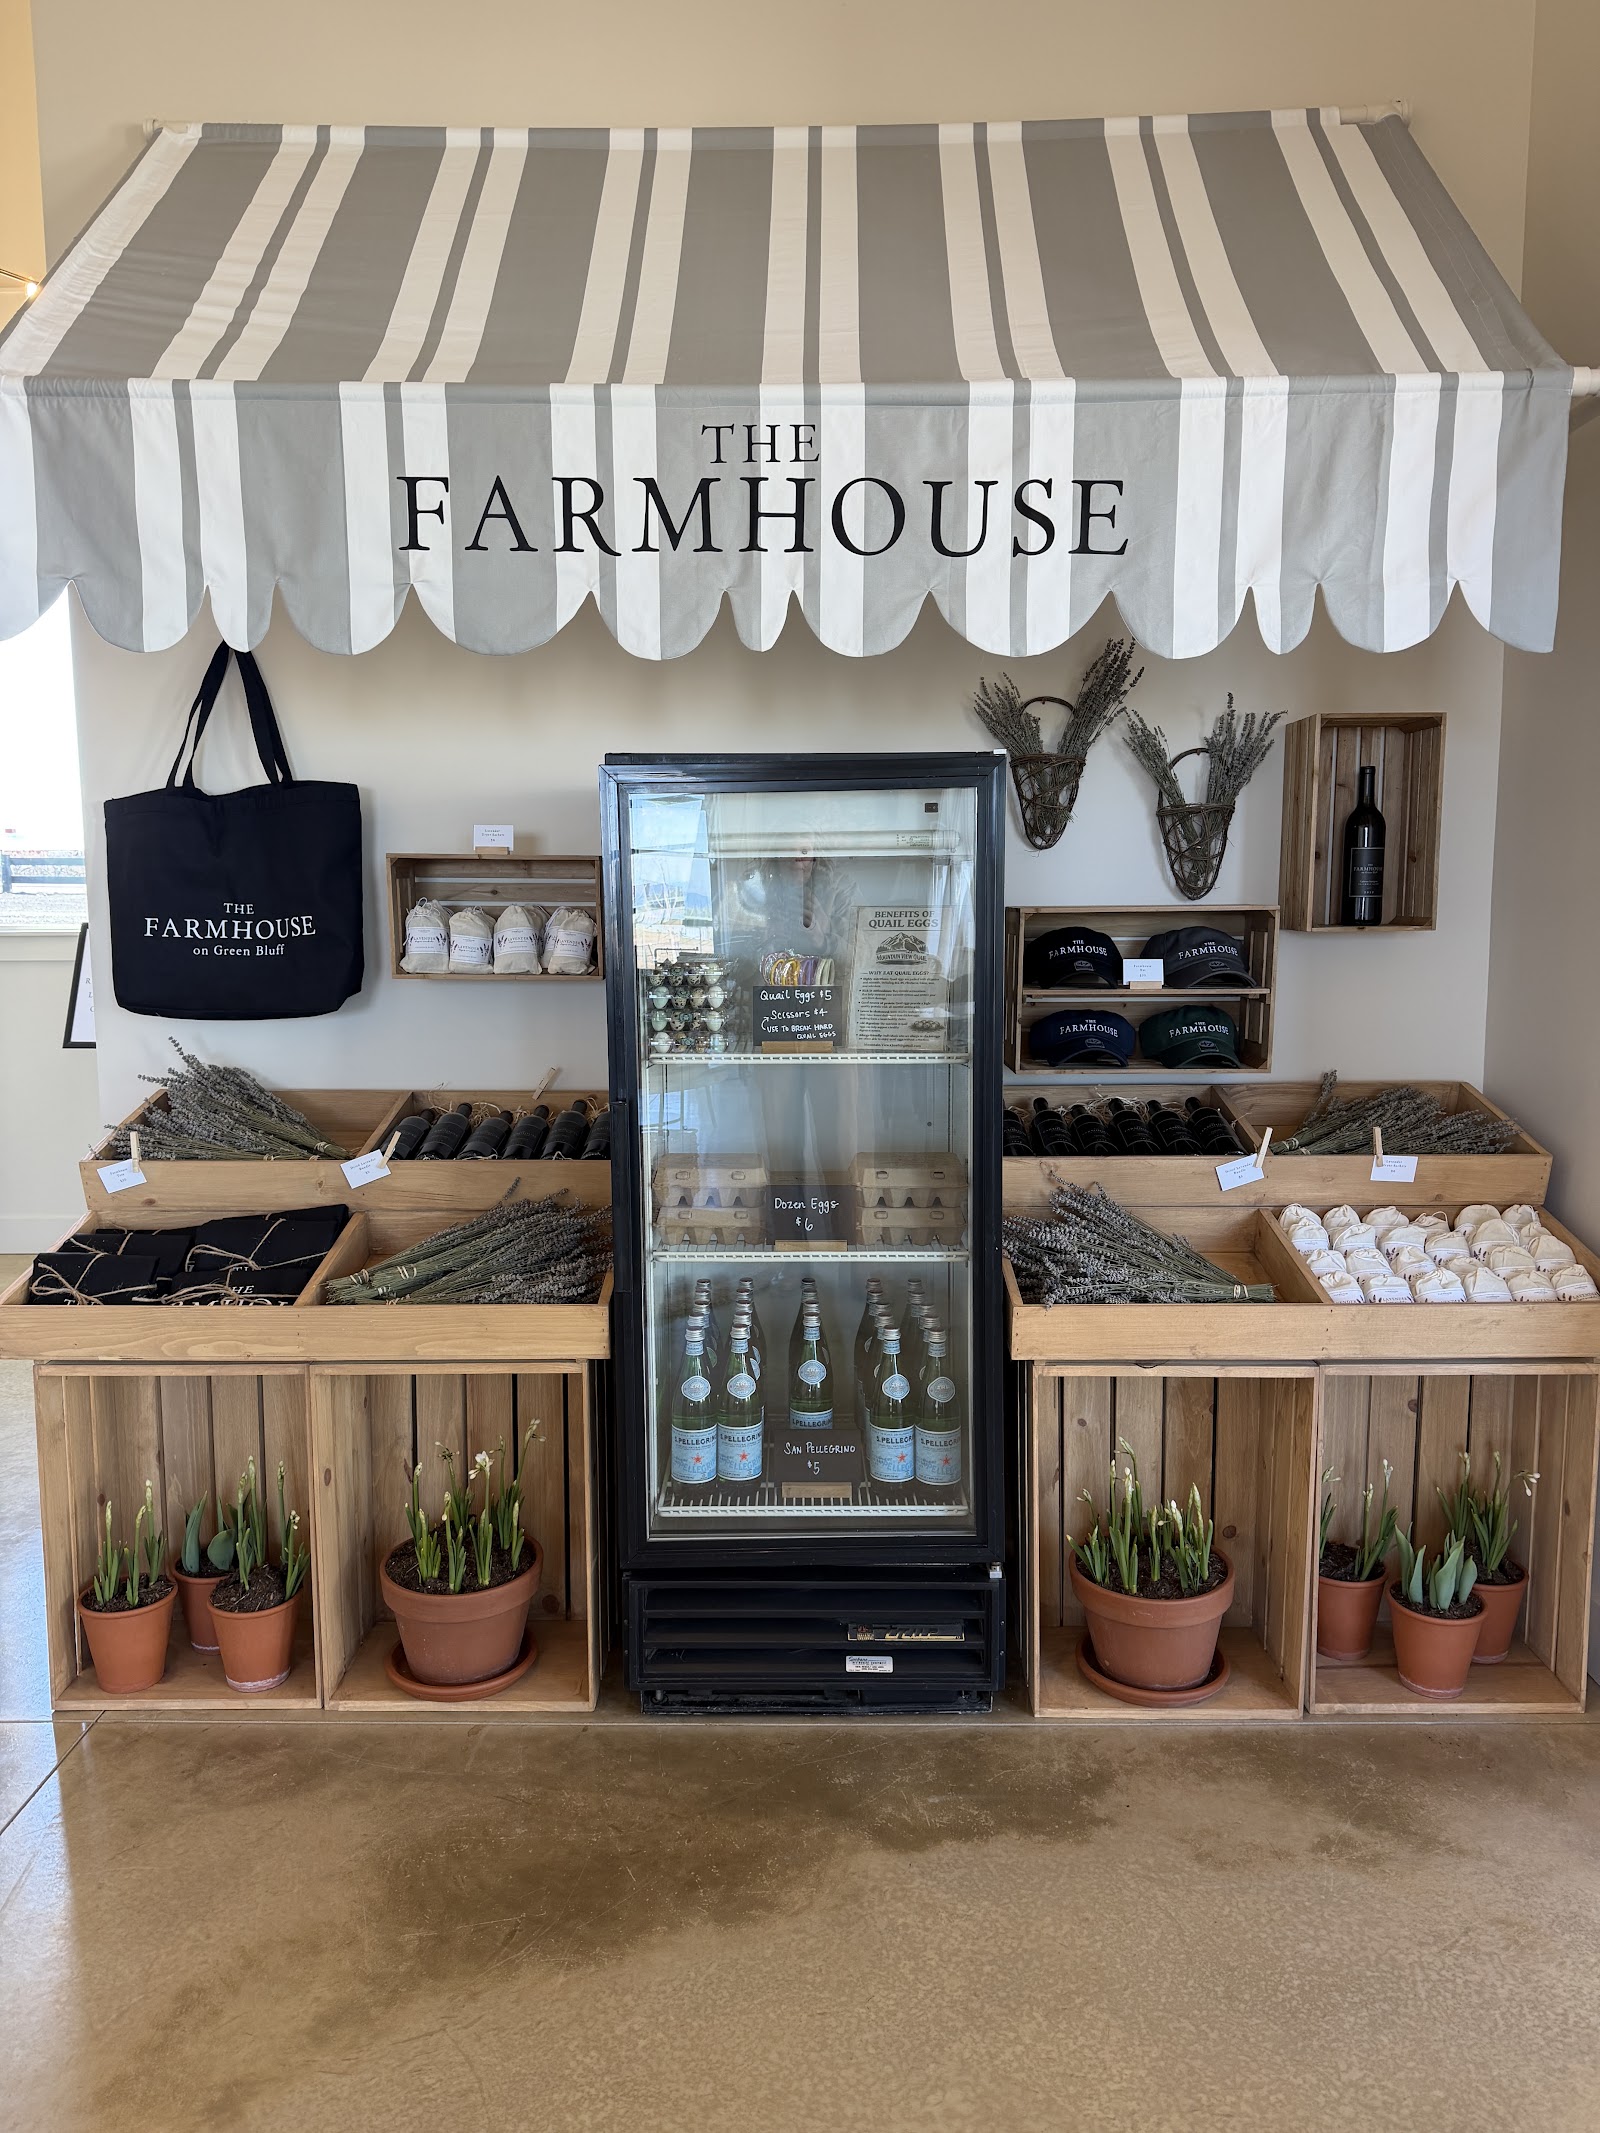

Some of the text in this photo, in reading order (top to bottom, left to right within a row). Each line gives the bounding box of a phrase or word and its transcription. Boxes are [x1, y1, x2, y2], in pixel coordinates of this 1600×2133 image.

[700, 423, 821, 464] THE
[396, 474, 1130, 557] FARMHOUSE
[223, 902, 255, 915] THE
[874, 910, 935, 918] BENEFITS OF
[143, 915, 317, 940] FARMHOUSE
[868, 919, 939, 929] QUAIL EGGS
[192, 943, 286, 956] on Green Bluff
[1048, 945, 1108, 960] FARMHOUSE
[1178, 945, 1239, 960] FARMHOUSE
[760, 989, 832, 1004] Quail Eggs $5
[770, 1007, 828, 1020] Scissors $4
[766, 1025, 779, 1033] USE
[791, 1024, 812, 1033] BREAK
[813, 1023, 833, 1031] HARD
[818, 1030, 837, 1039] EGGS
[1059, 1023, 1119, 1038] FARMHOUSE
[1168, 1024, 1230, 1038] FARMHOUSE
[774, 1197, 840, 1214] Dozen Eggs
[795, 1216, 814, 1231] $6
[783, 1441, 856, 1455] SAN PELLEGRINO
[807, 1460, 821, 1475] $5
